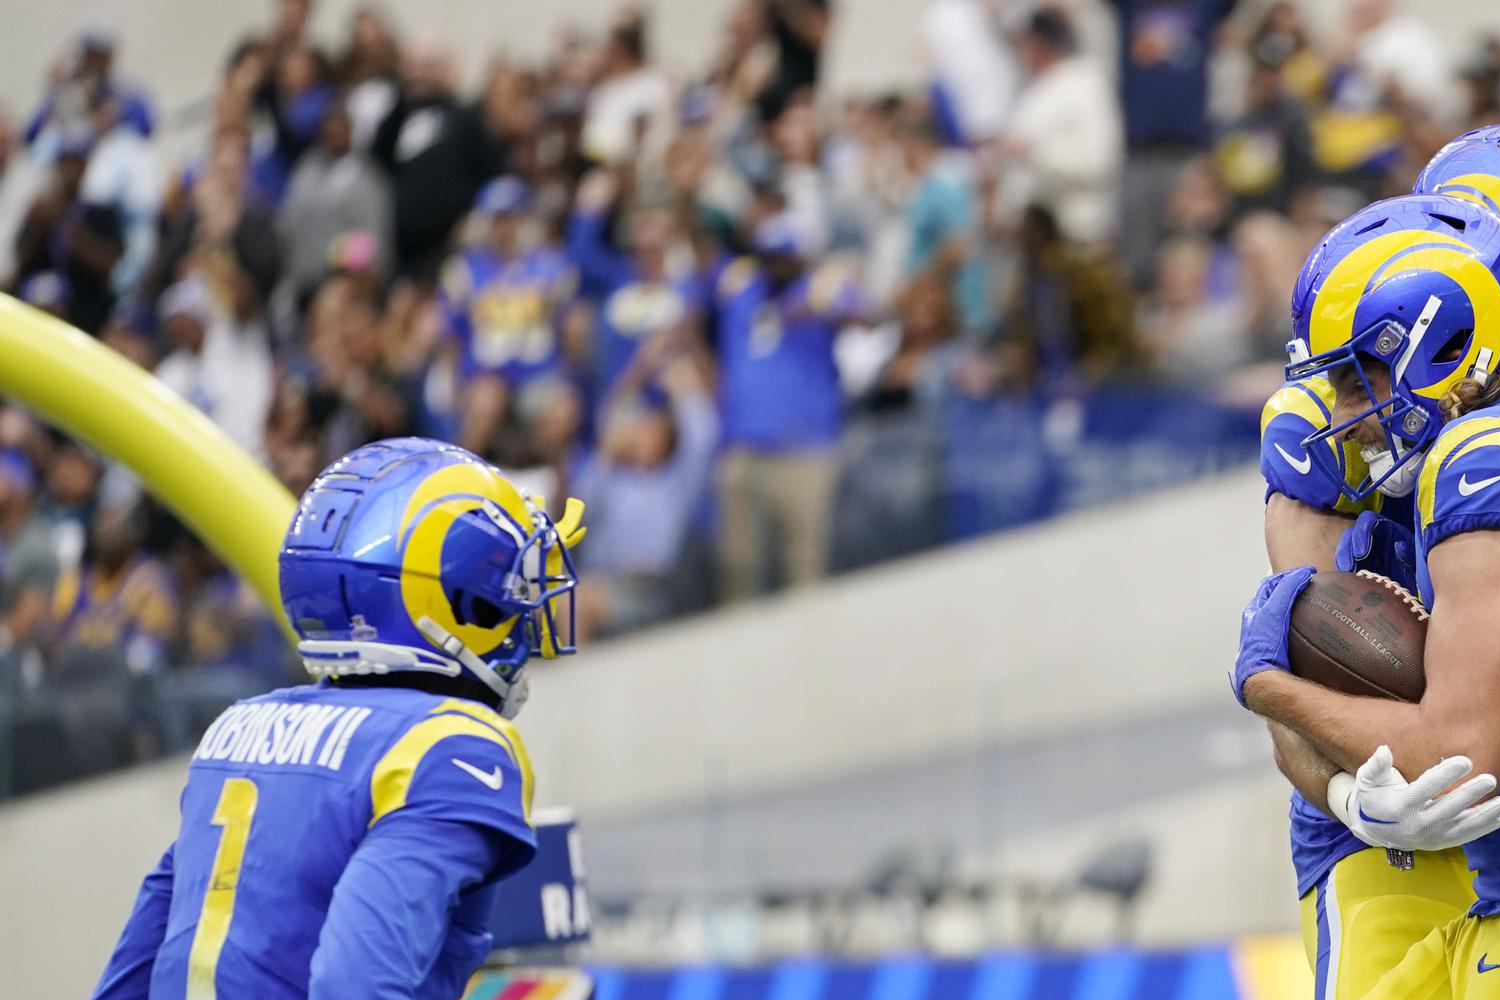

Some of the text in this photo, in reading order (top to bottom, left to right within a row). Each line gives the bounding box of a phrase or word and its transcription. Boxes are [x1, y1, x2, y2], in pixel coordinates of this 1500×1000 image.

[1331, 608, 1370, 641] FOOTBALL
[1370, 638, 1402, 669] LEAGUE
[191, 702, 347, 766] OBINSON
